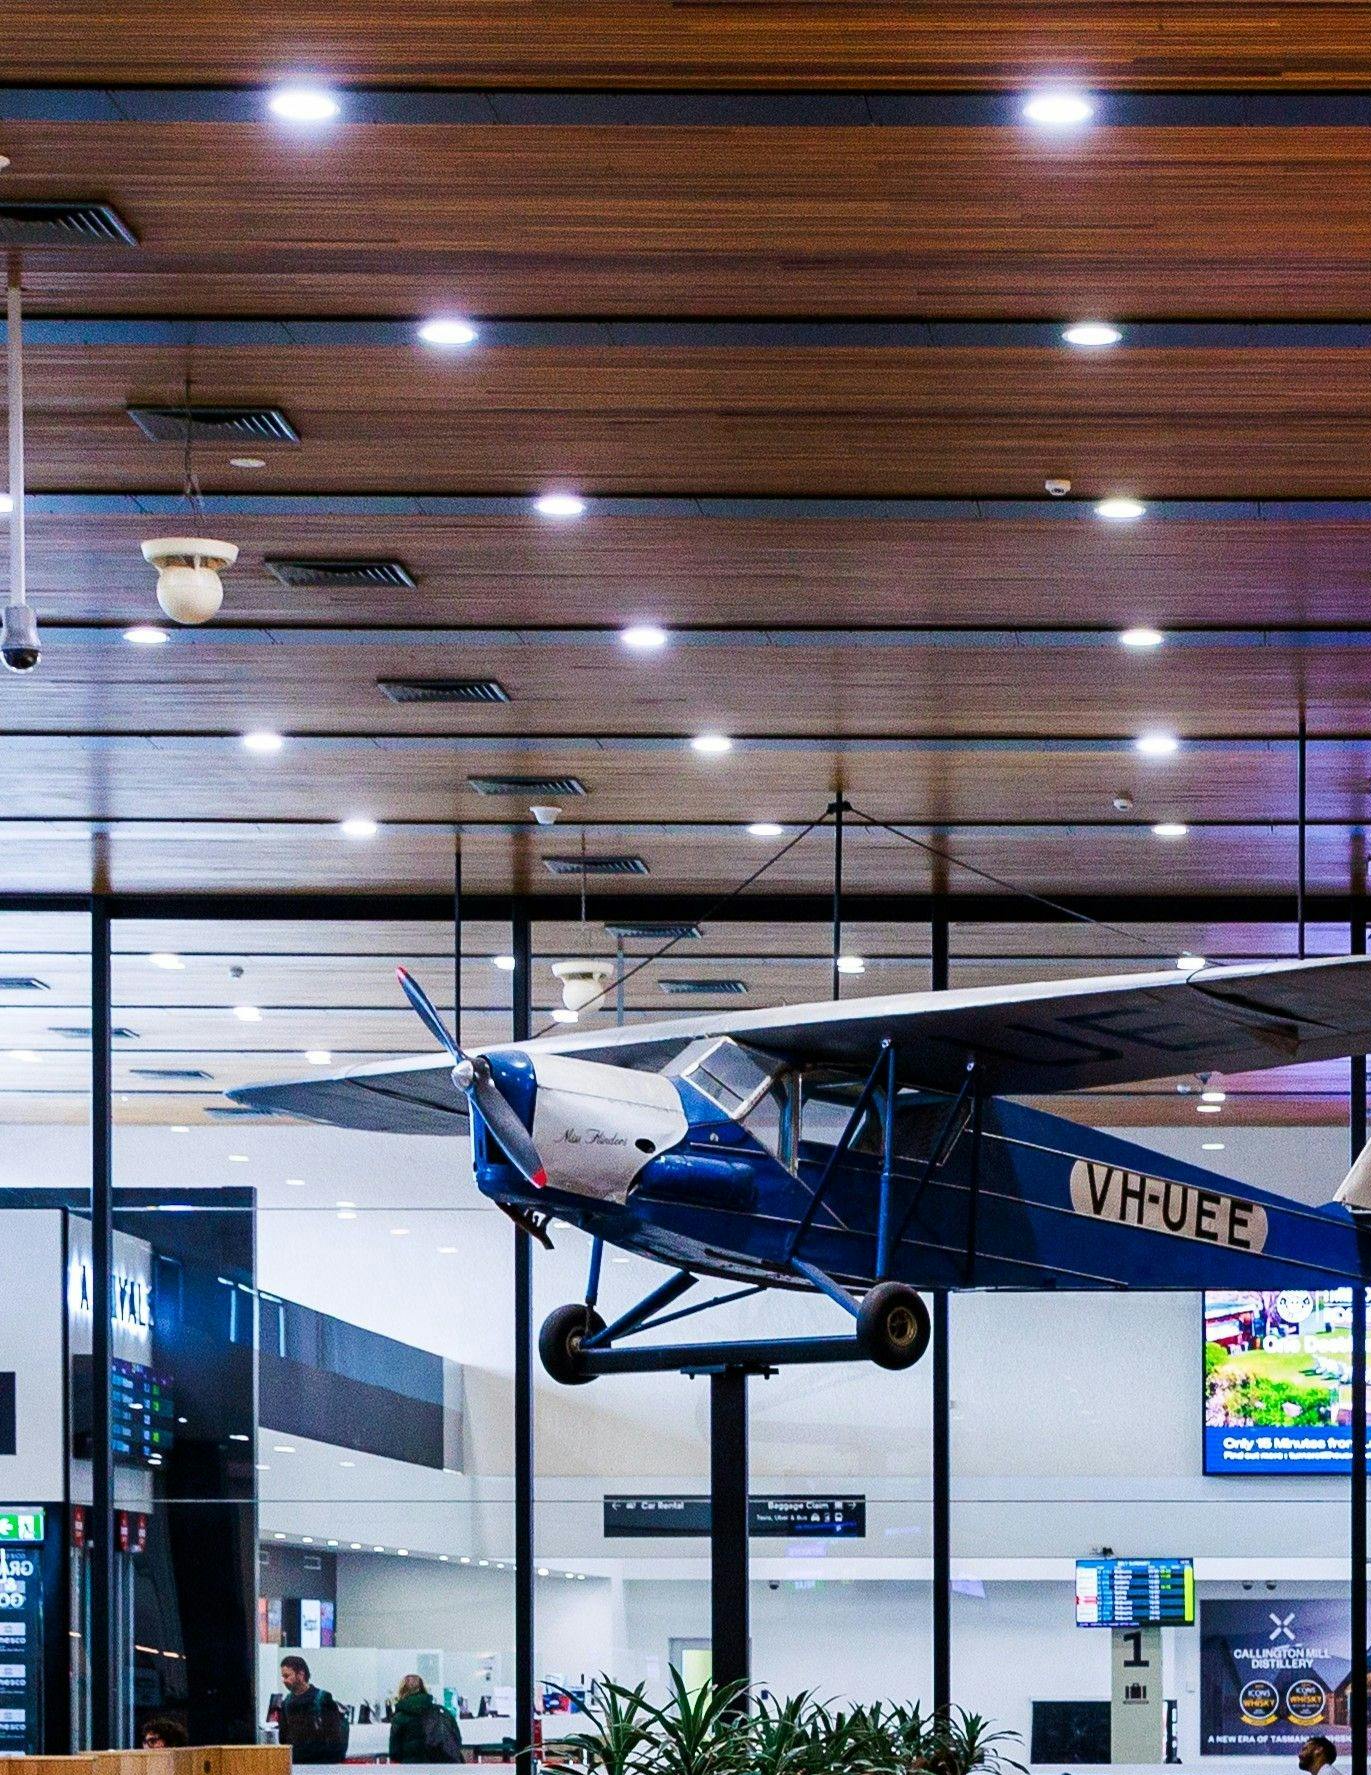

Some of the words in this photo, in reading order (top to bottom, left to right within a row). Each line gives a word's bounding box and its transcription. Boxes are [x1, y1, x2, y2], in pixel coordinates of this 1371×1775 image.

[1087, 1163, 1253, 1249] VH-UEE
[1123, 1631, 1149, 1667] 1
[1234, 1648, 1306, 1660] CALLINGTON
[1307, 1648, 1330, 1659] MILL
[1251, 1658, 1314, 1670] DISTILLERY
[1208, 1735, 1215, 1743] A
[1216, 1735, 1237, 1743] NEW
[1238, 1735, 1255, 1743] ERA
[1257, 1735, 1268, 1743] OF
